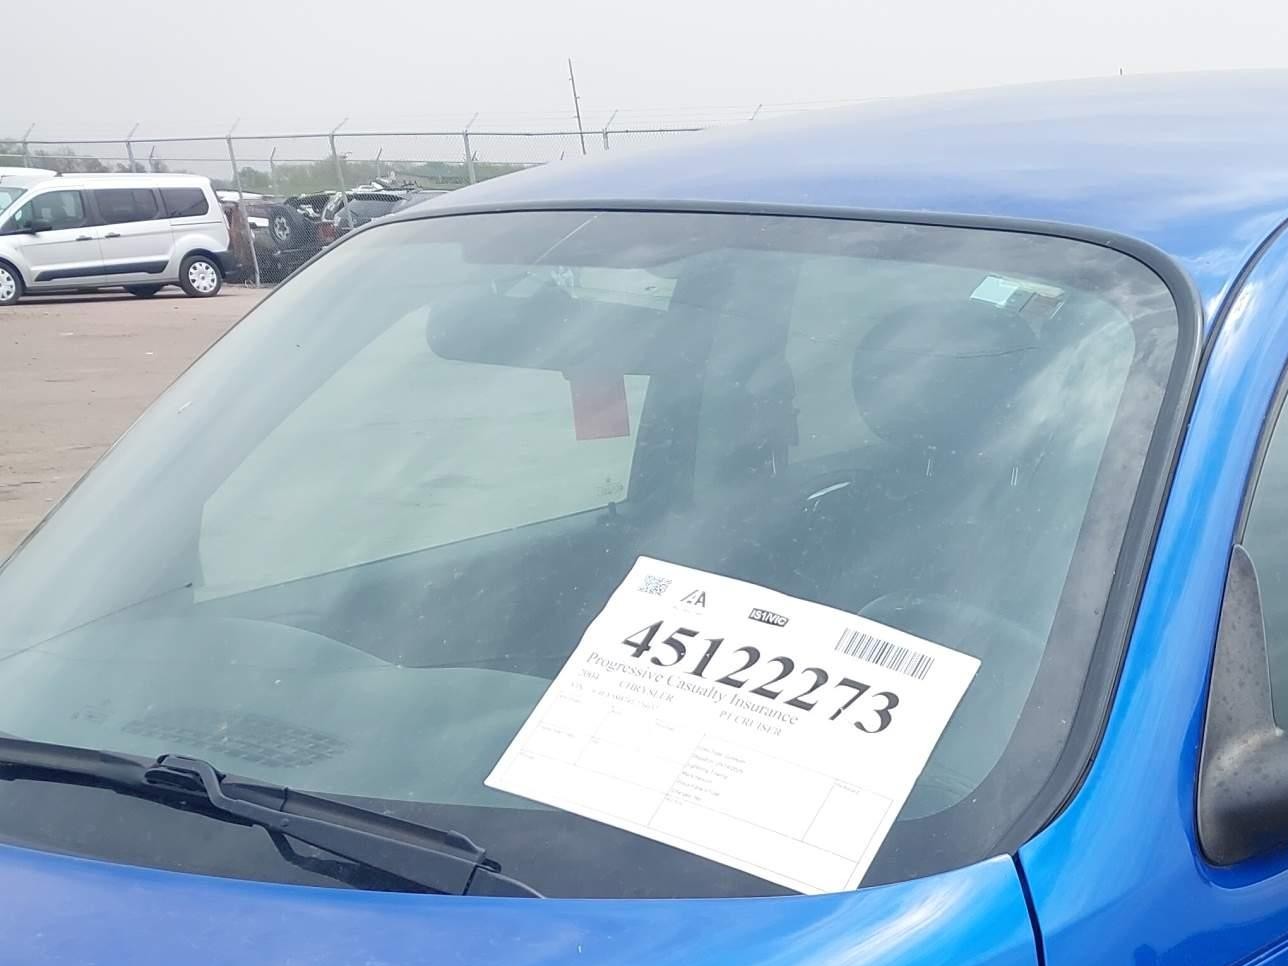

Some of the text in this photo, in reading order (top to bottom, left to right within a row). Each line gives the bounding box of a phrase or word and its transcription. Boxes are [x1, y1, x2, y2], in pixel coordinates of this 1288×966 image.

[586, 651, 664, 683] Progressive
[667, 674, 727, 704] Casualty
[729, 693, 799, 725] Insurance
[619, 681, 675, 703] CHRYSLER
[621, 619, 900, 735] 45122273
[733, 716, 783, 736] CRUISER
